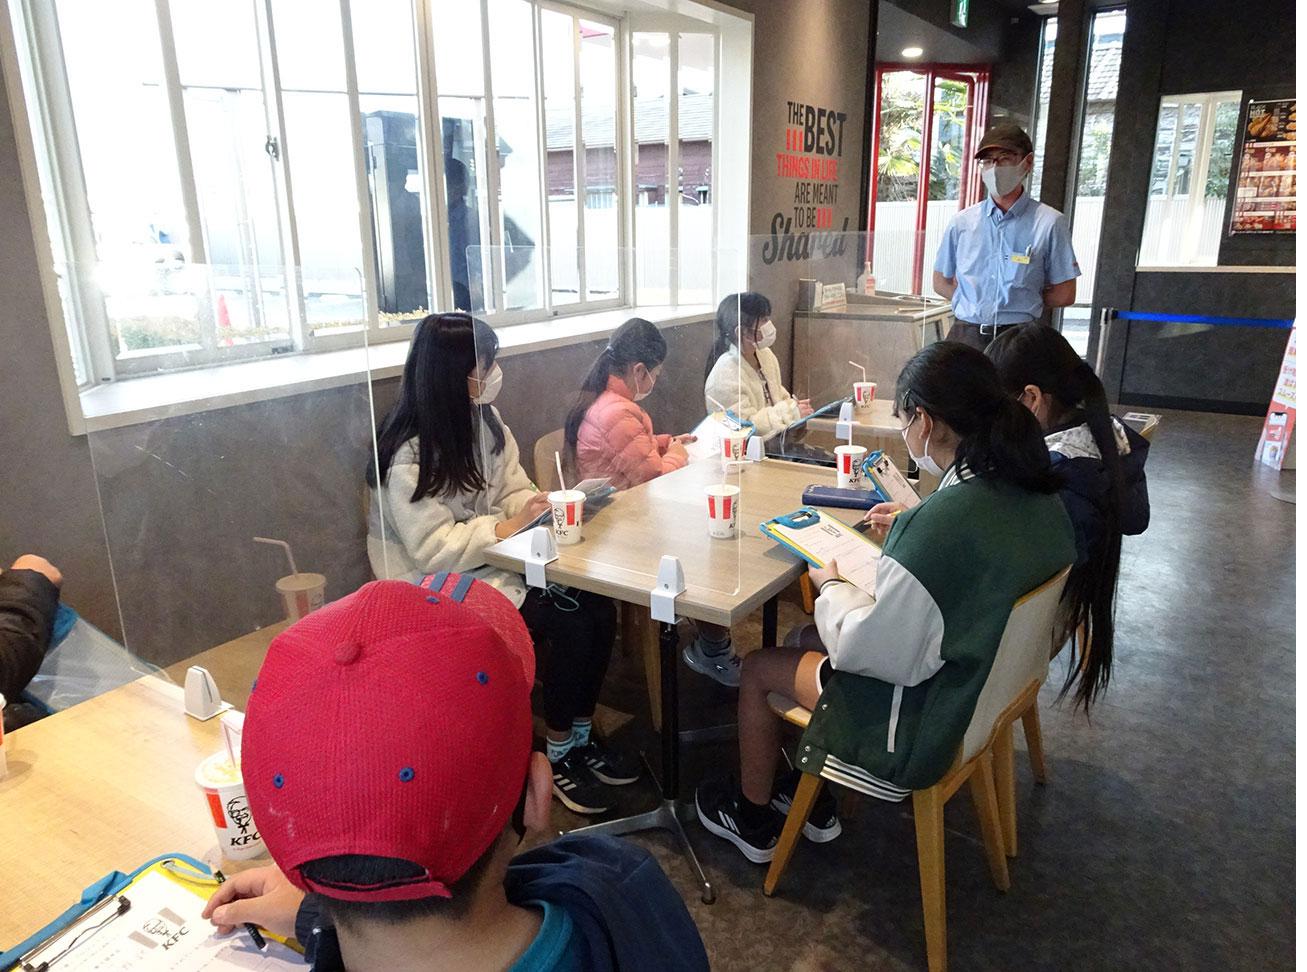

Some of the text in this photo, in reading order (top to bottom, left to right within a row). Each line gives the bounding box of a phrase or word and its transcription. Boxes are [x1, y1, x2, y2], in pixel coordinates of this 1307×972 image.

[787, 101, 847, 157] THE BEST
[776, 152, 810, 178] THINGS
[810, 157, 821, 180] IN
[794, 182, 839, 204] ARE MEANT
[793, 207, 816, 228] TO BE
[762, 212, 849, 265] Shared
[231, 832, 261, 846] KFC
[162, 926, 190, 951] KFC
